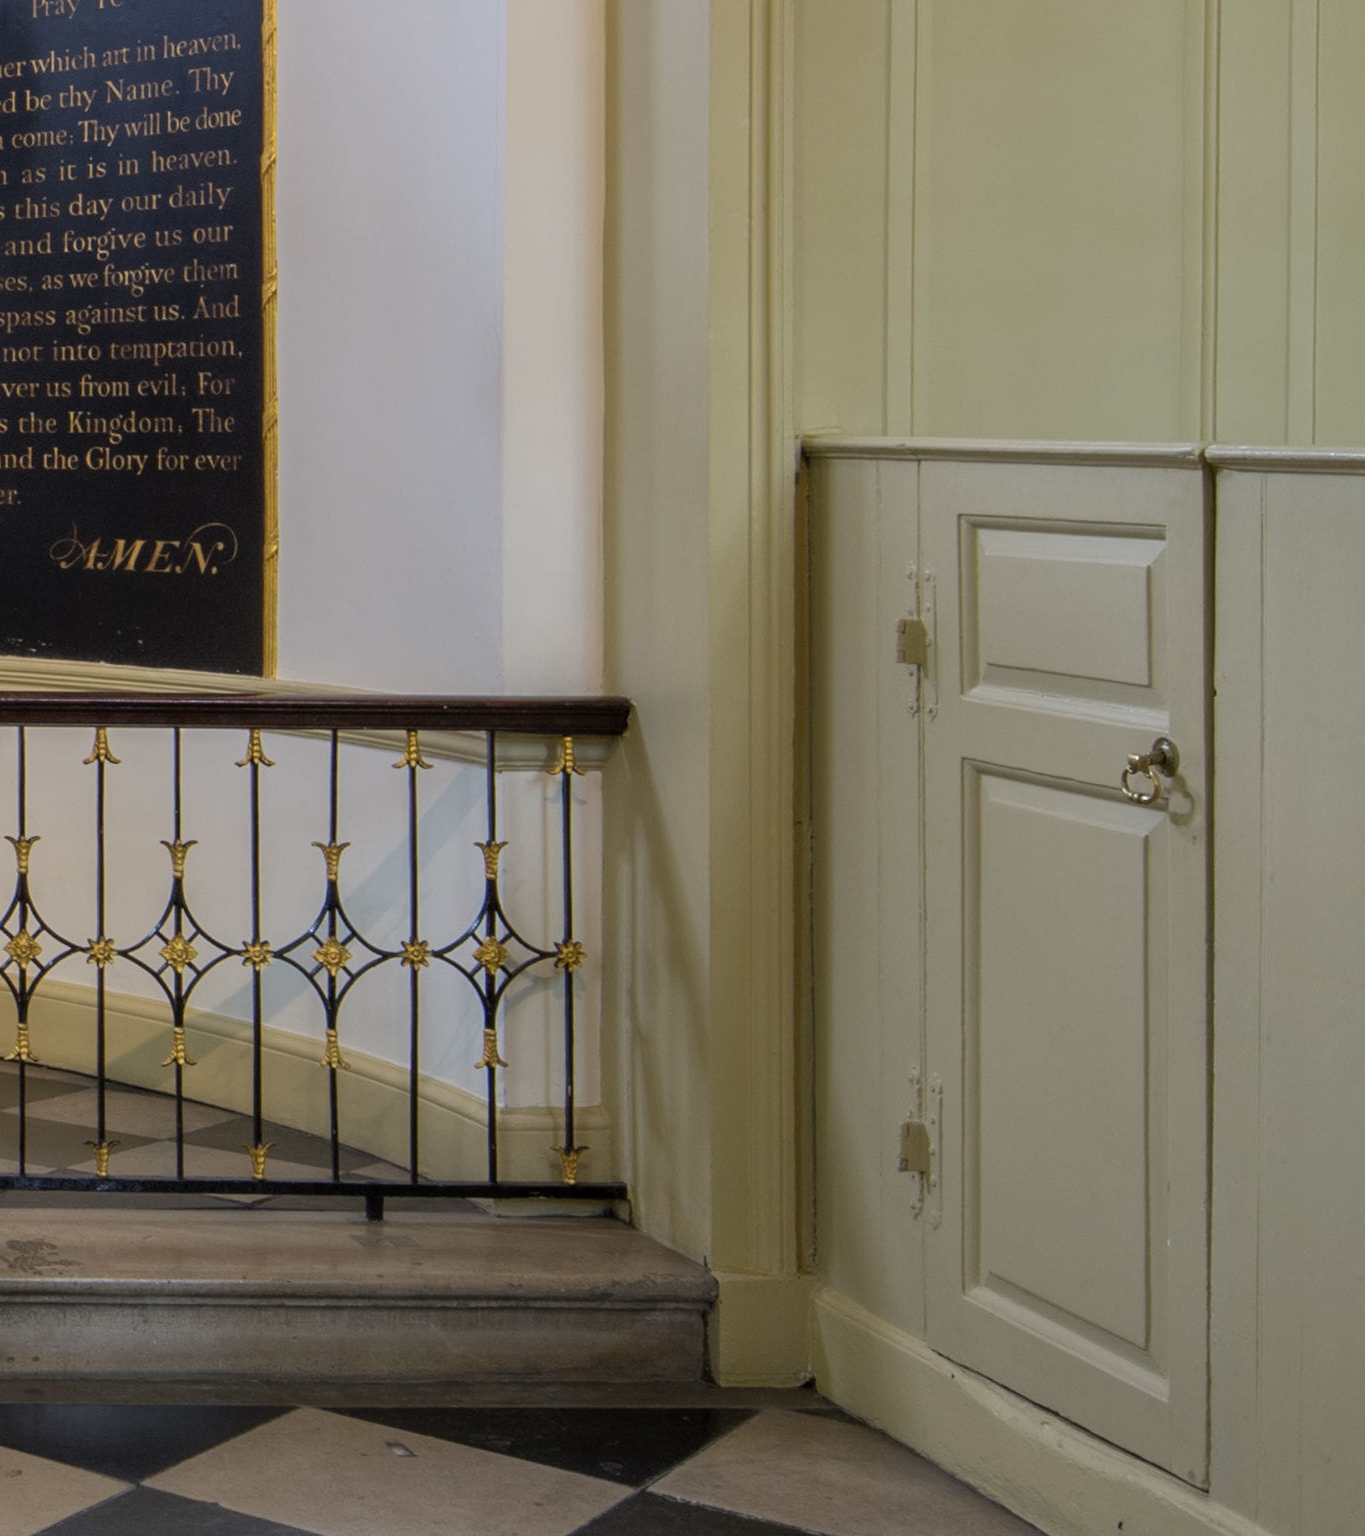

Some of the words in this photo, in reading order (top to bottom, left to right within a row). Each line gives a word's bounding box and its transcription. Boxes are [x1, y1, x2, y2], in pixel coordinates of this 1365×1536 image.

[30, 46, 96, 74] which
[102, 48, 130, 67] art
[136, 40, 156, 62] in
[25, 89, 52, 112] be
[59, 85, 97, 112] thy
[105, 79, 179, 103] Name.
[188, 67, 234, 96] Thy
[77, 120, 120, 147] Thy
[124, 112, 161, 137] will
[167, 111, 191, 133] be
[195, 106, 242, 130] done
[21, 168, 46, 184] as
[59, 159, 77, 181] it
[87, 157, 107, 179] is
[118, 153, 139, 176] in
[151, 149, 237, 173] heaven.
[15, 197, 60, 219] this
[69, 193, 114, 221] day
[121, 194, 162, 212] our
[169, 182, 234, 210] daily
[5, 232, 53, 256] and
[62, 228, 146, 261] forgive
[155, 229, 182, 247] us
[193, 225, 234, 244] our
[42, 274, 63, 290] as
[69, 273, 98, 288] we
[103, 262, 175, 298] forgive
[183, 258, 239, 283] them
[65, 302, 147, 335] against
[153, 304, 185, 321] us.
[193, 294, 240, 319] And
[3, 346, 44, 362] not
[53, 340, 101, 361] into
[110, 334, 242, 366] temptation,
[46, 382, 71, 397] us
[79, 373, 129, 397] from
[198, 372, 235, 395] For
[18, 412, 57, 434] the
[191, 408, 235, 432] The
[43, 446, 79, 470] the
[85, 446, 149, 475] Glory
[157, 447, 189, 470] for
[194, 455, 242, 471] ever
